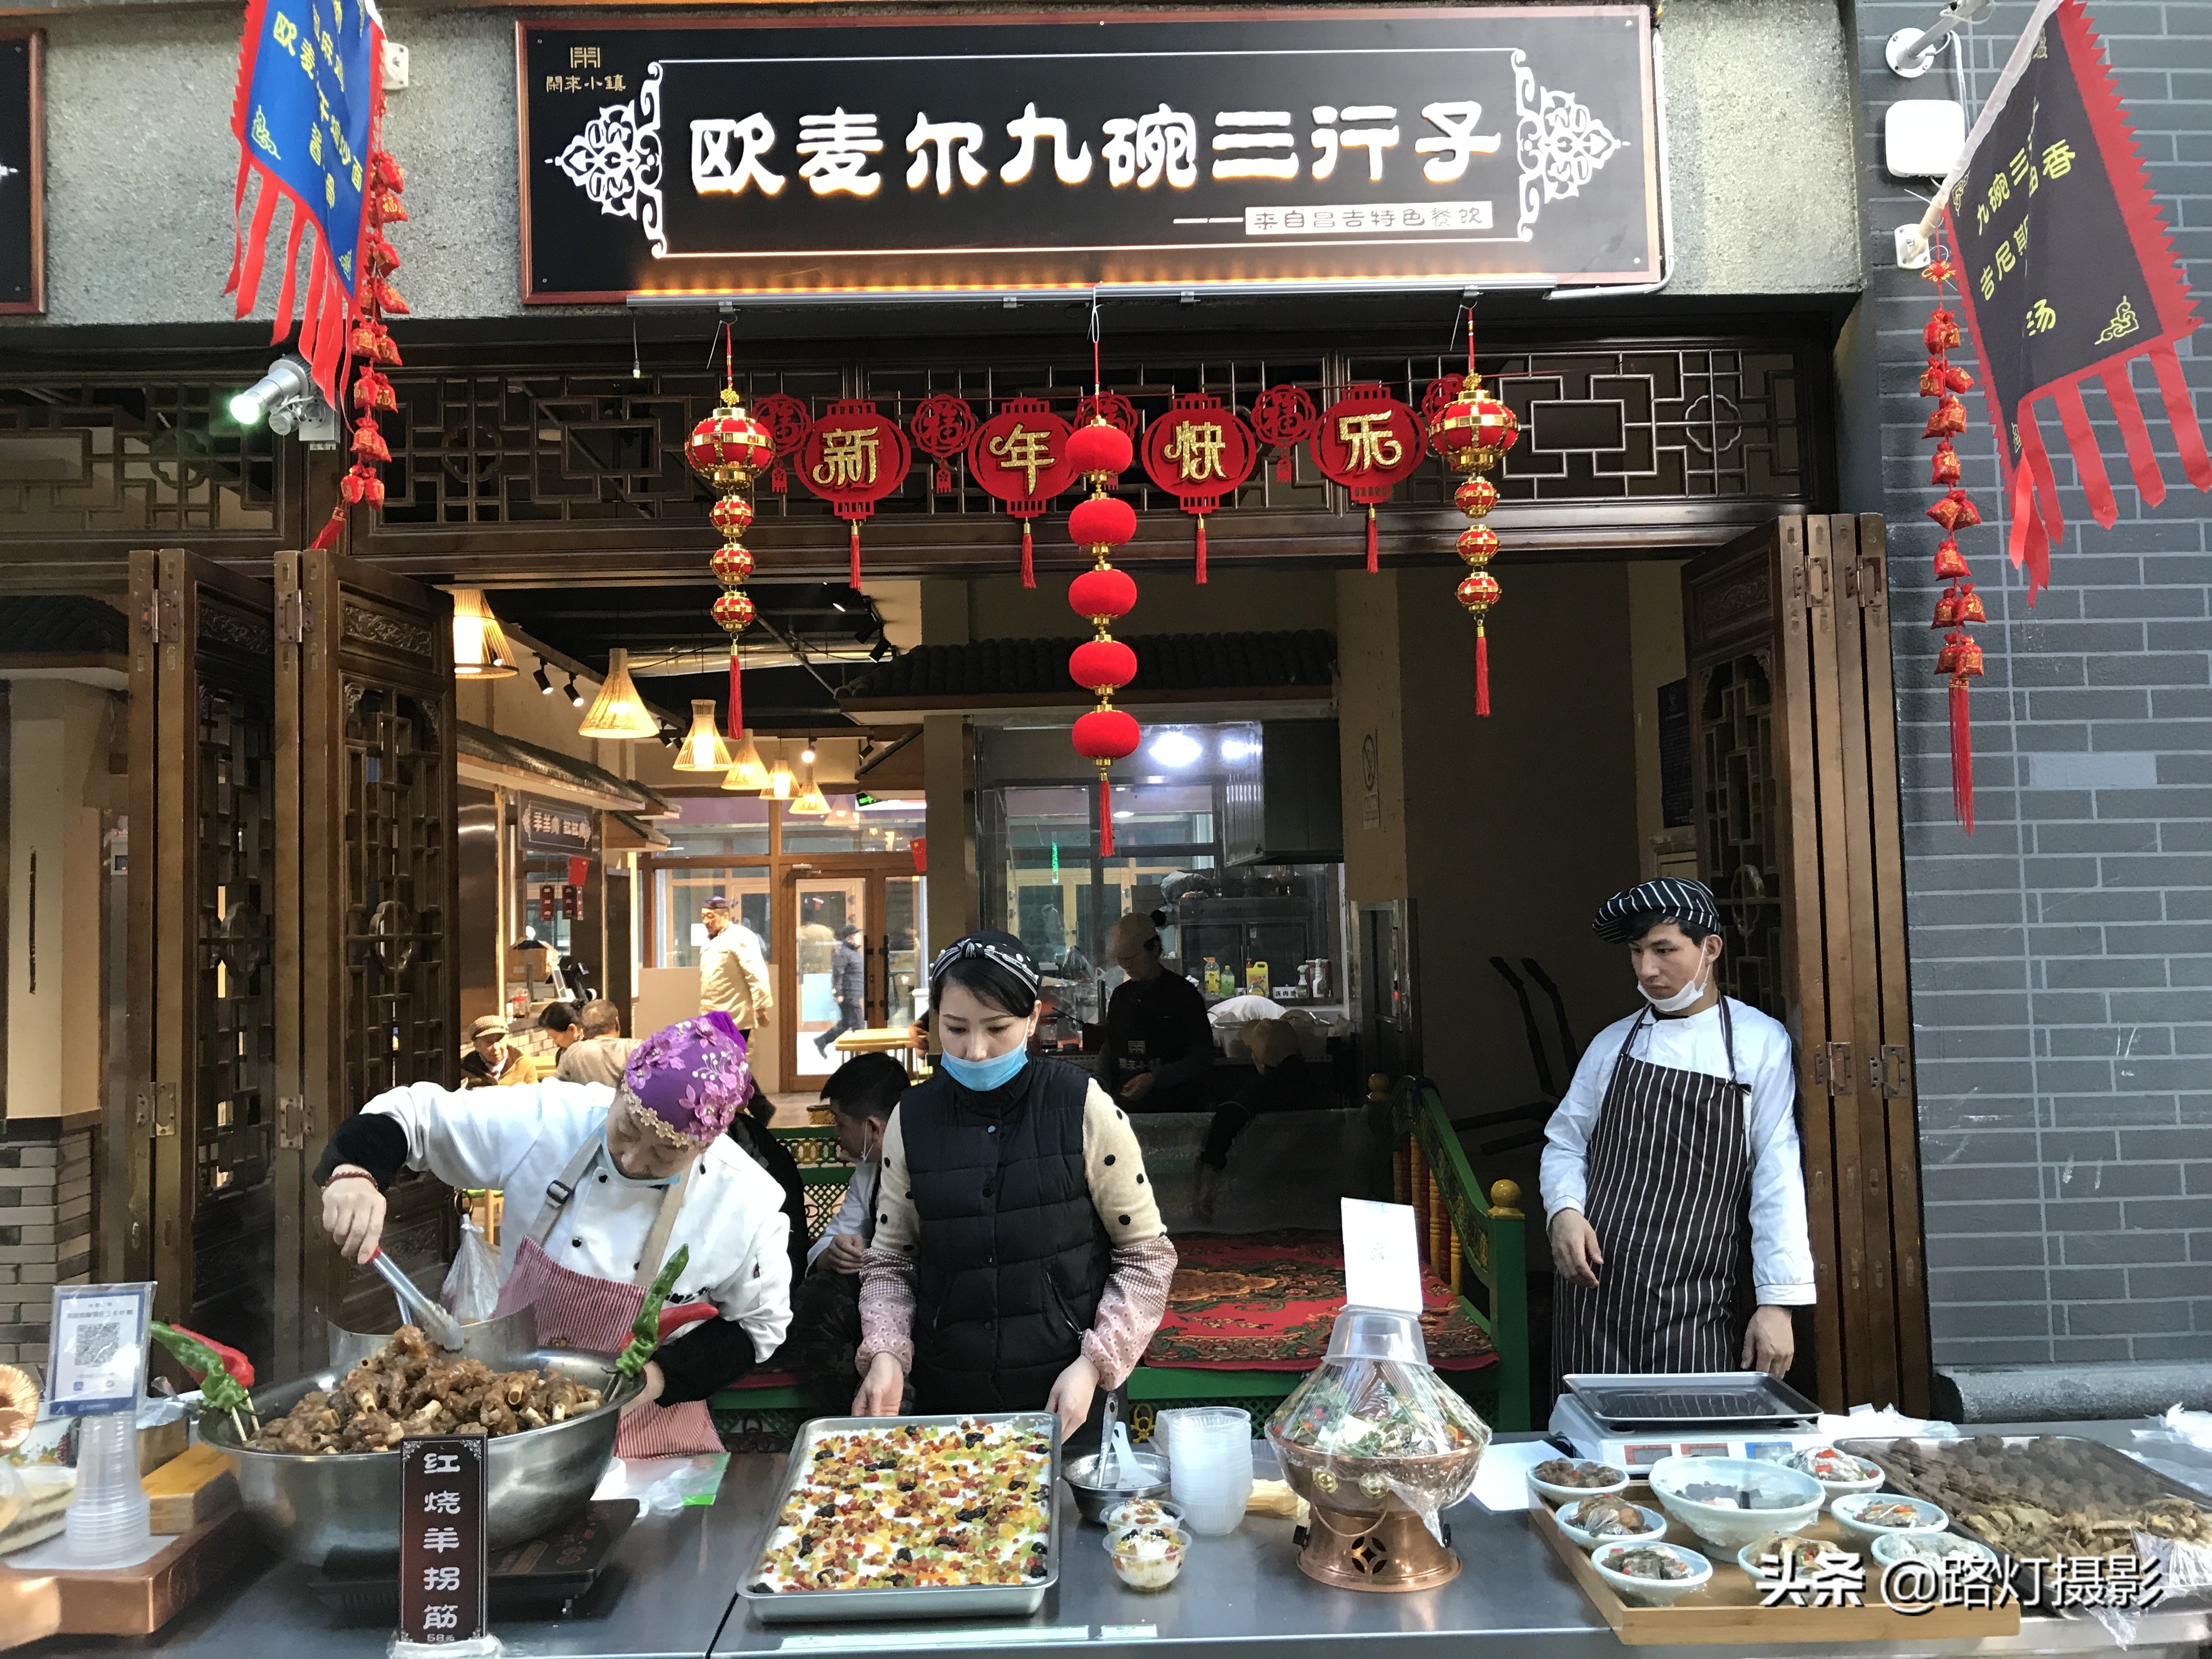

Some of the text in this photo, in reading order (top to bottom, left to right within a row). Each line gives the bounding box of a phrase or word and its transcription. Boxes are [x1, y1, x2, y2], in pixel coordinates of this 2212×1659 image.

[690, 101, 1501, 195] 欧麦尔九碗三行子
[1253, 207, 1483, 230] 来自昌吉特色餐饮
[812, 426, 879, 486] 新
[989, 423, 1056, 495] 年
[1164, 420, 1229, 481] 快
[423, 1452, 461, 1630] 红烧羊拐筋
